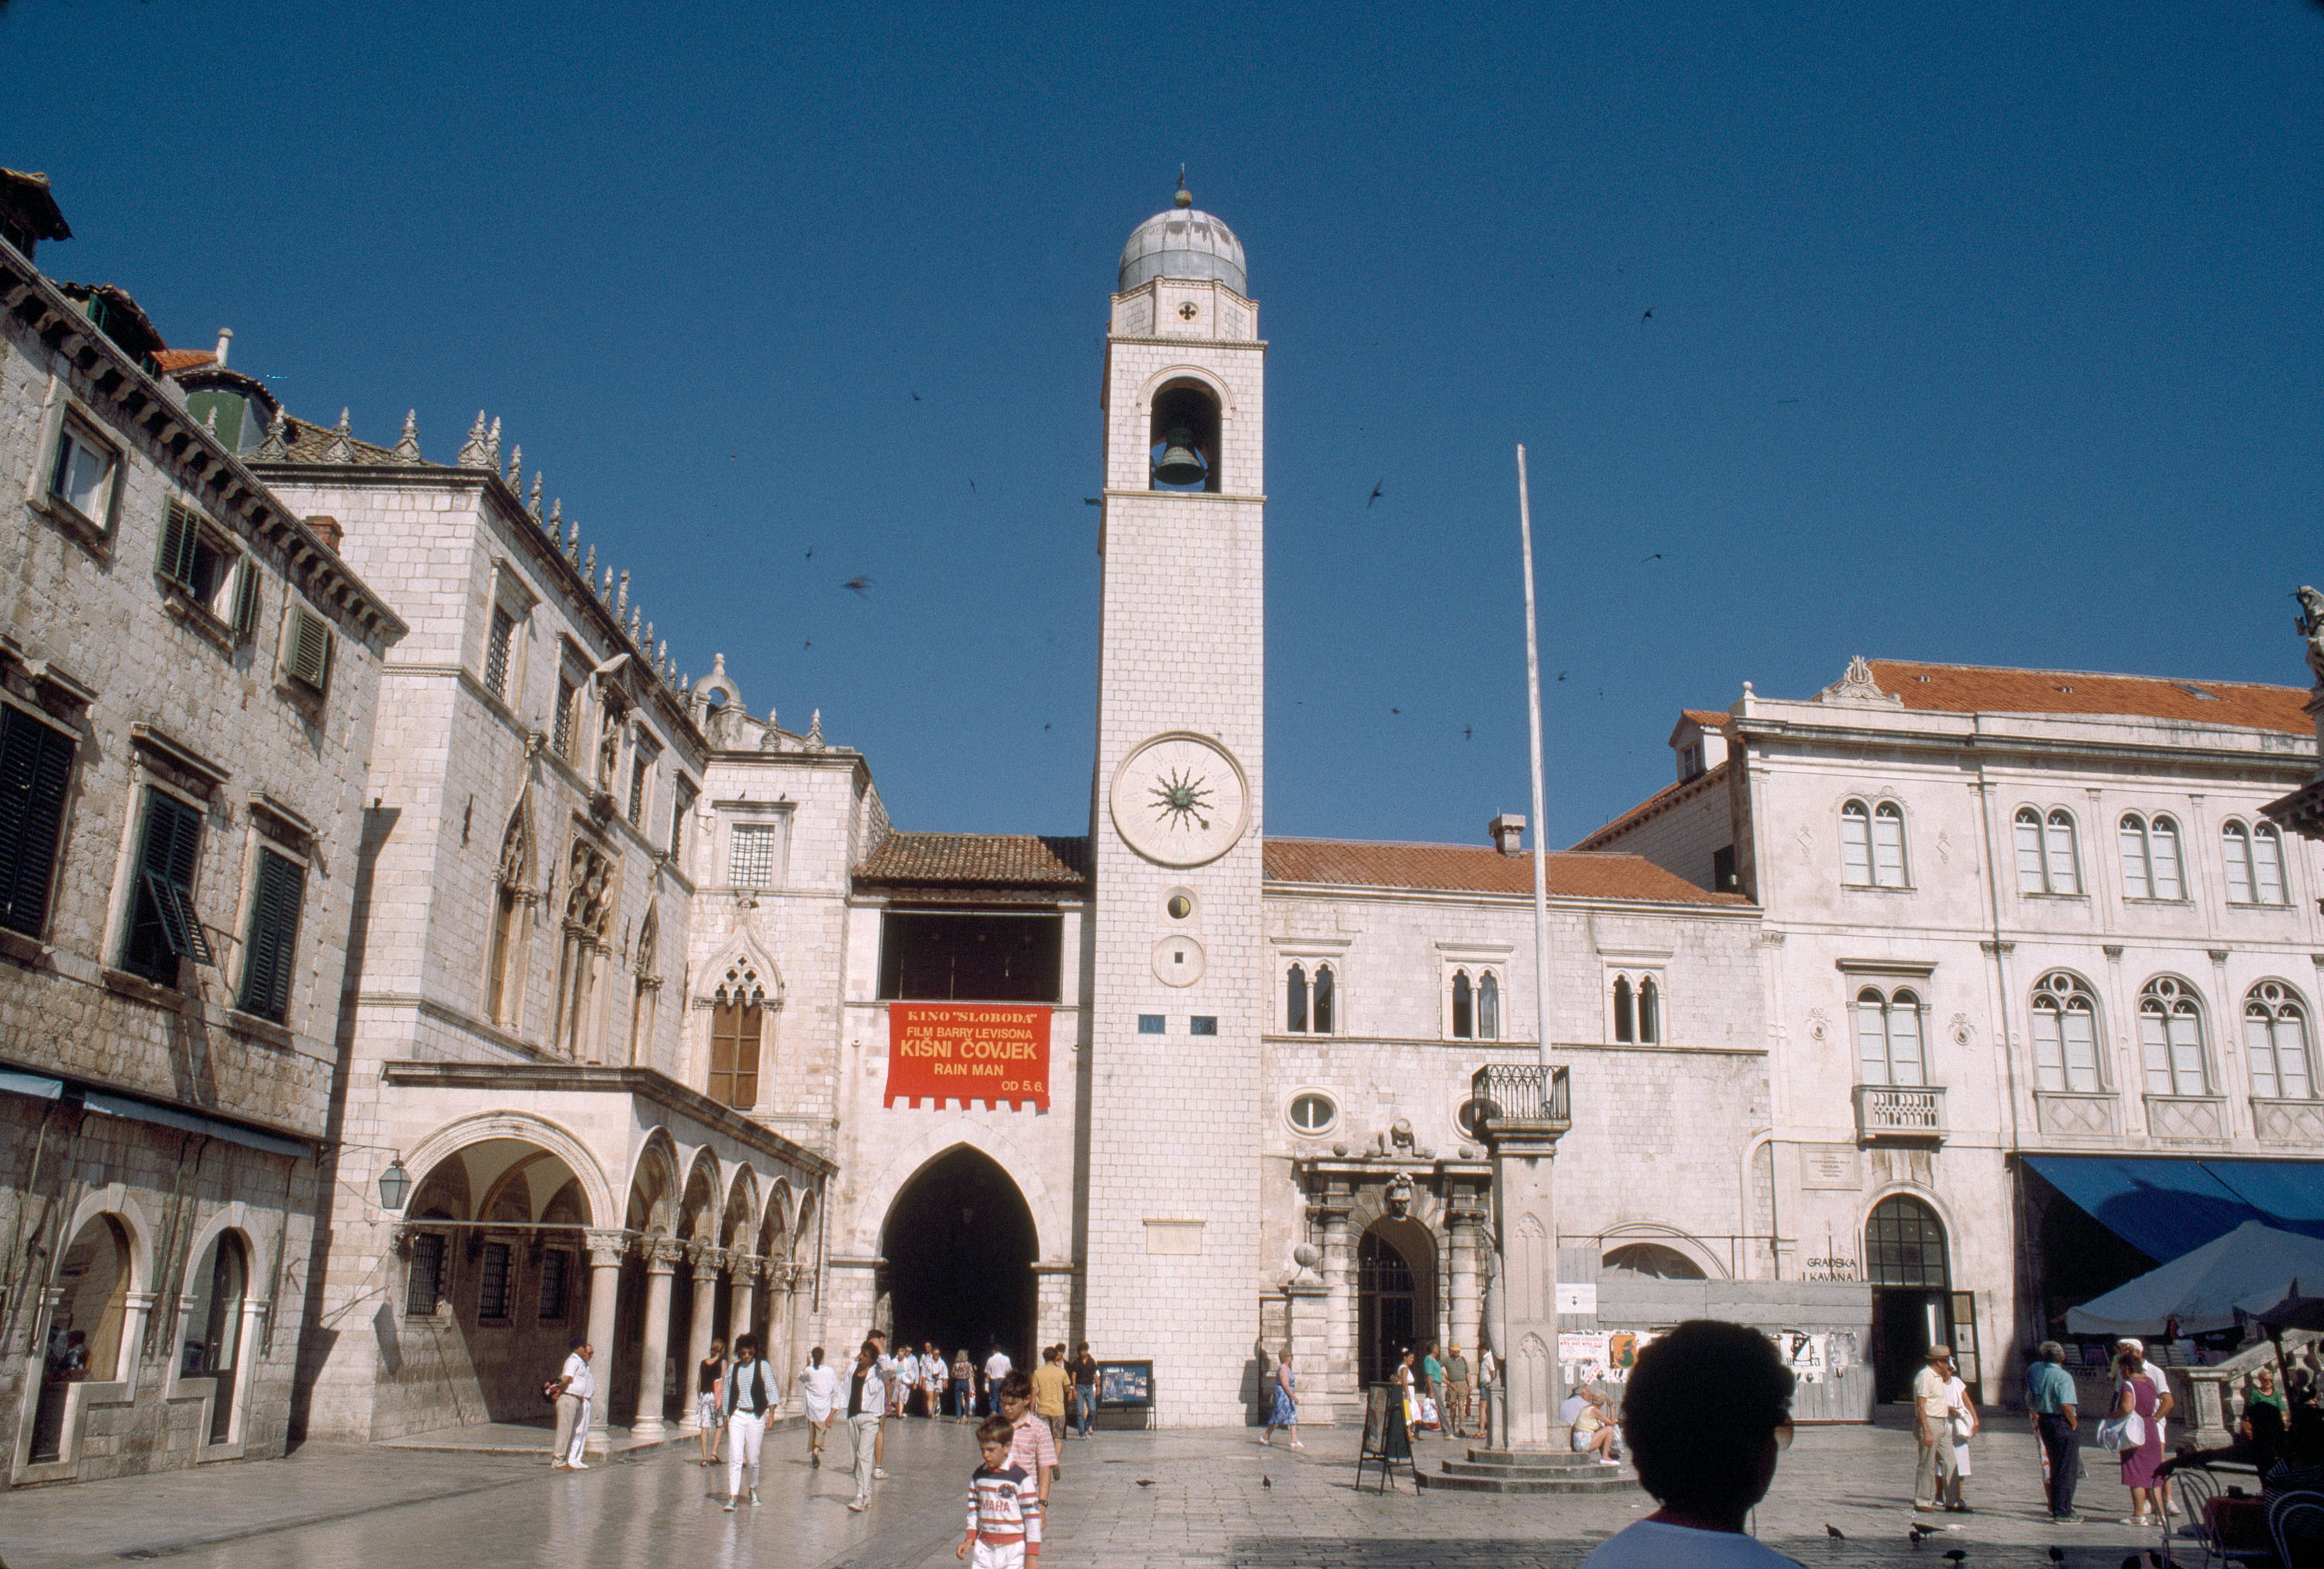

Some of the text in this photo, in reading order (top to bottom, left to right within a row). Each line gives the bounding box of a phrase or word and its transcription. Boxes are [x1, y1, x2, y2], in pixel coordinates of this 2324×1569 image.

[908, 1011, 950, 1021] KINO
[907, 1027, 1033, 1039] FILM BARRY LEVISONA
[900, 1037, 1037, 1060] KIŠNI ČOVJEK
[933, 1063, 1004, 1076] RAIN MAN
[1002, 1081, 1019, 1091] OD
[1807, 1258, 1856, 1268] GRADSKA
[1810, 1272, 1853, 1282] KAVANA
